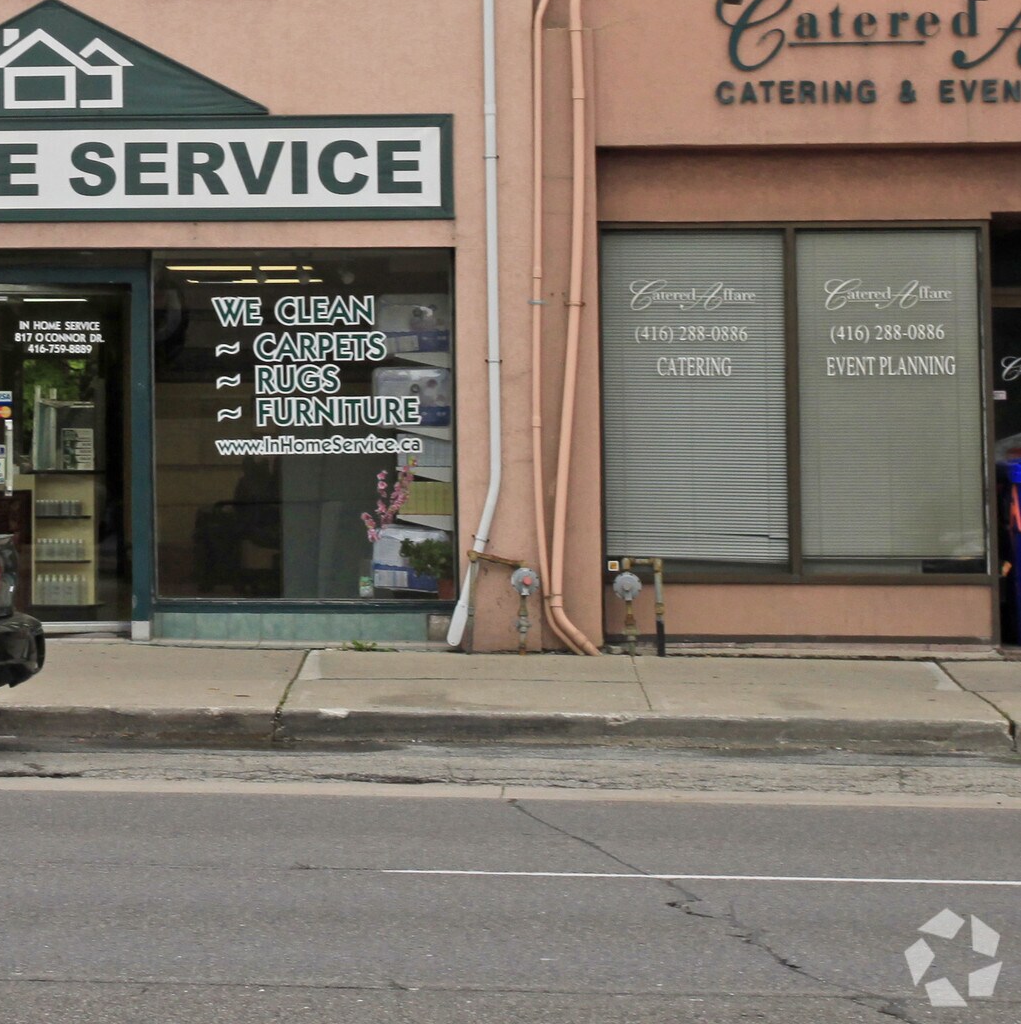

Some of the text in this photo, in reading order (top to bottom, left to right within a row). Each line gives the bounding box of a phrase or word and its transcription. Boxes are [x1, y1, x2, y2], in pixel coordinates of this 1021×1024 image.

[715, 79, 876, 105] CATERING
[898, 79, 916, 104] &
[69, 139, 422, 196] SERVICE
[629, 279, 697, 311] Catered
[824, 278, 892, 311] Catered
[211, 295, 375, 327] WE CLEAN
[14, 333, 33, 342] 817
[18, 320, 100, 331] IN HOME SERVICE
[635, 326, 748, 343] (416) 288-0886
[830, 324, 945, 344] (416) 288-0886
[27, 344, 93, 354] 416-759-8889
[253, 331, 388, 362] CARPETS
[656, 357, 732, 377] CATERING
[826, 355, 956, 376] EVENT PLANNING
[255, 364, 341, 394] RUGS
[256, 396, 422, 426] FURNITURE
[215, 433, 423, 455] www.InHomeService.ca
